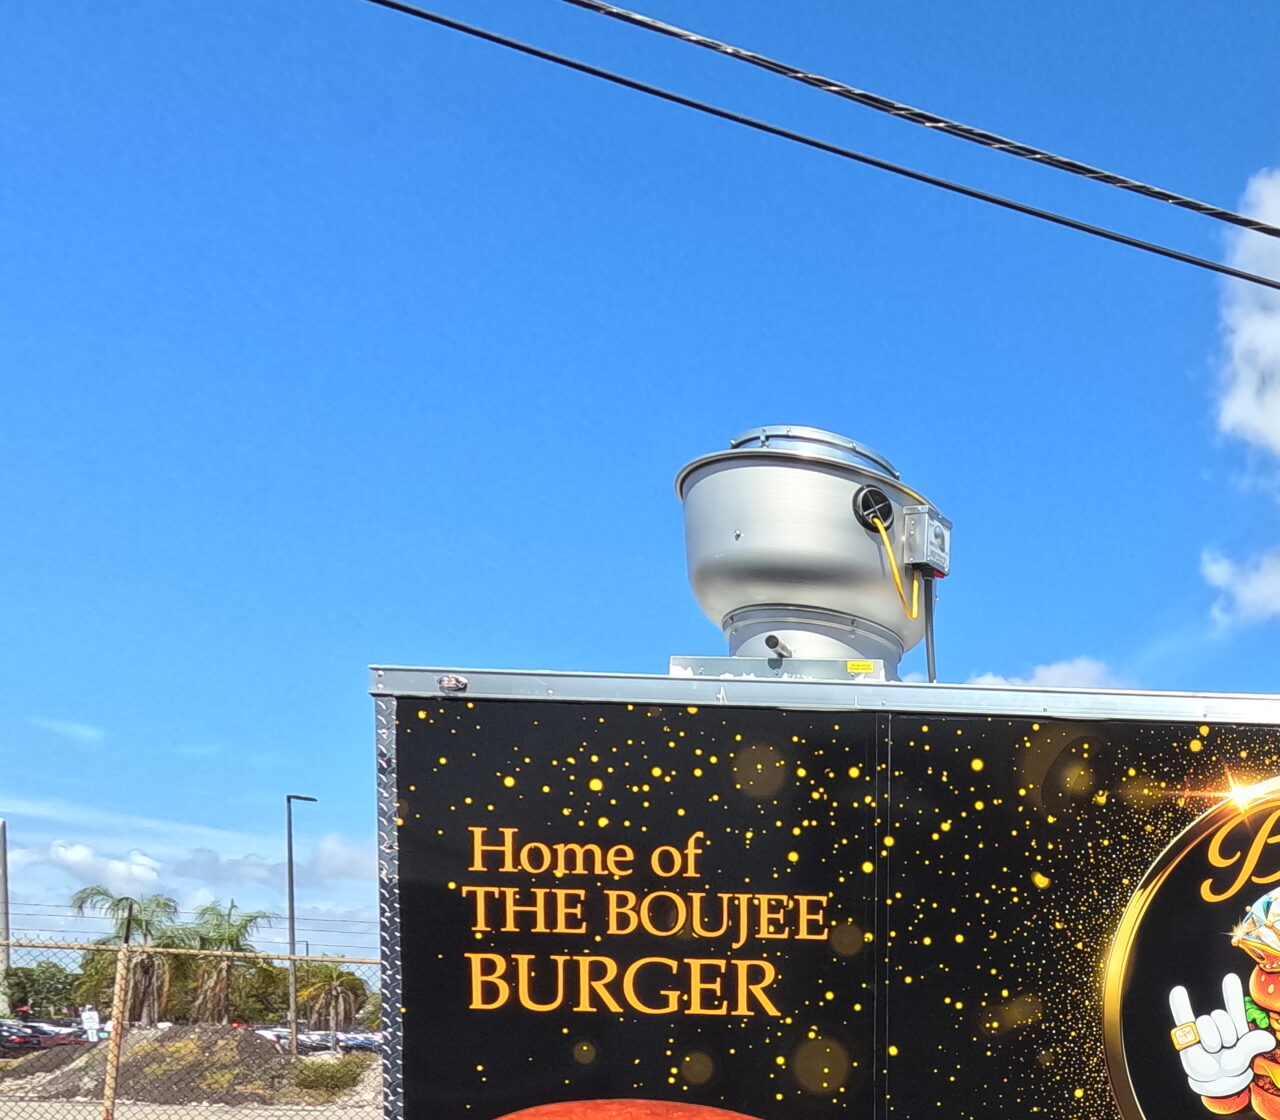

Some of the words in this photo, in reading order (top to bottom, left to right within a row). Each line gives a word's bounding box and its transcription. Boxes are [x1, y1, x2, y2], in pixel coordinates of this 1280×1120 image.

[467, 826, 634, 877] Home
[650, 831, 704, 878] of
[461, 885, 587, 934] THE
[603, 889, 829, 950] BOUJEE
[464, 952, 781, 1017] BURGER
